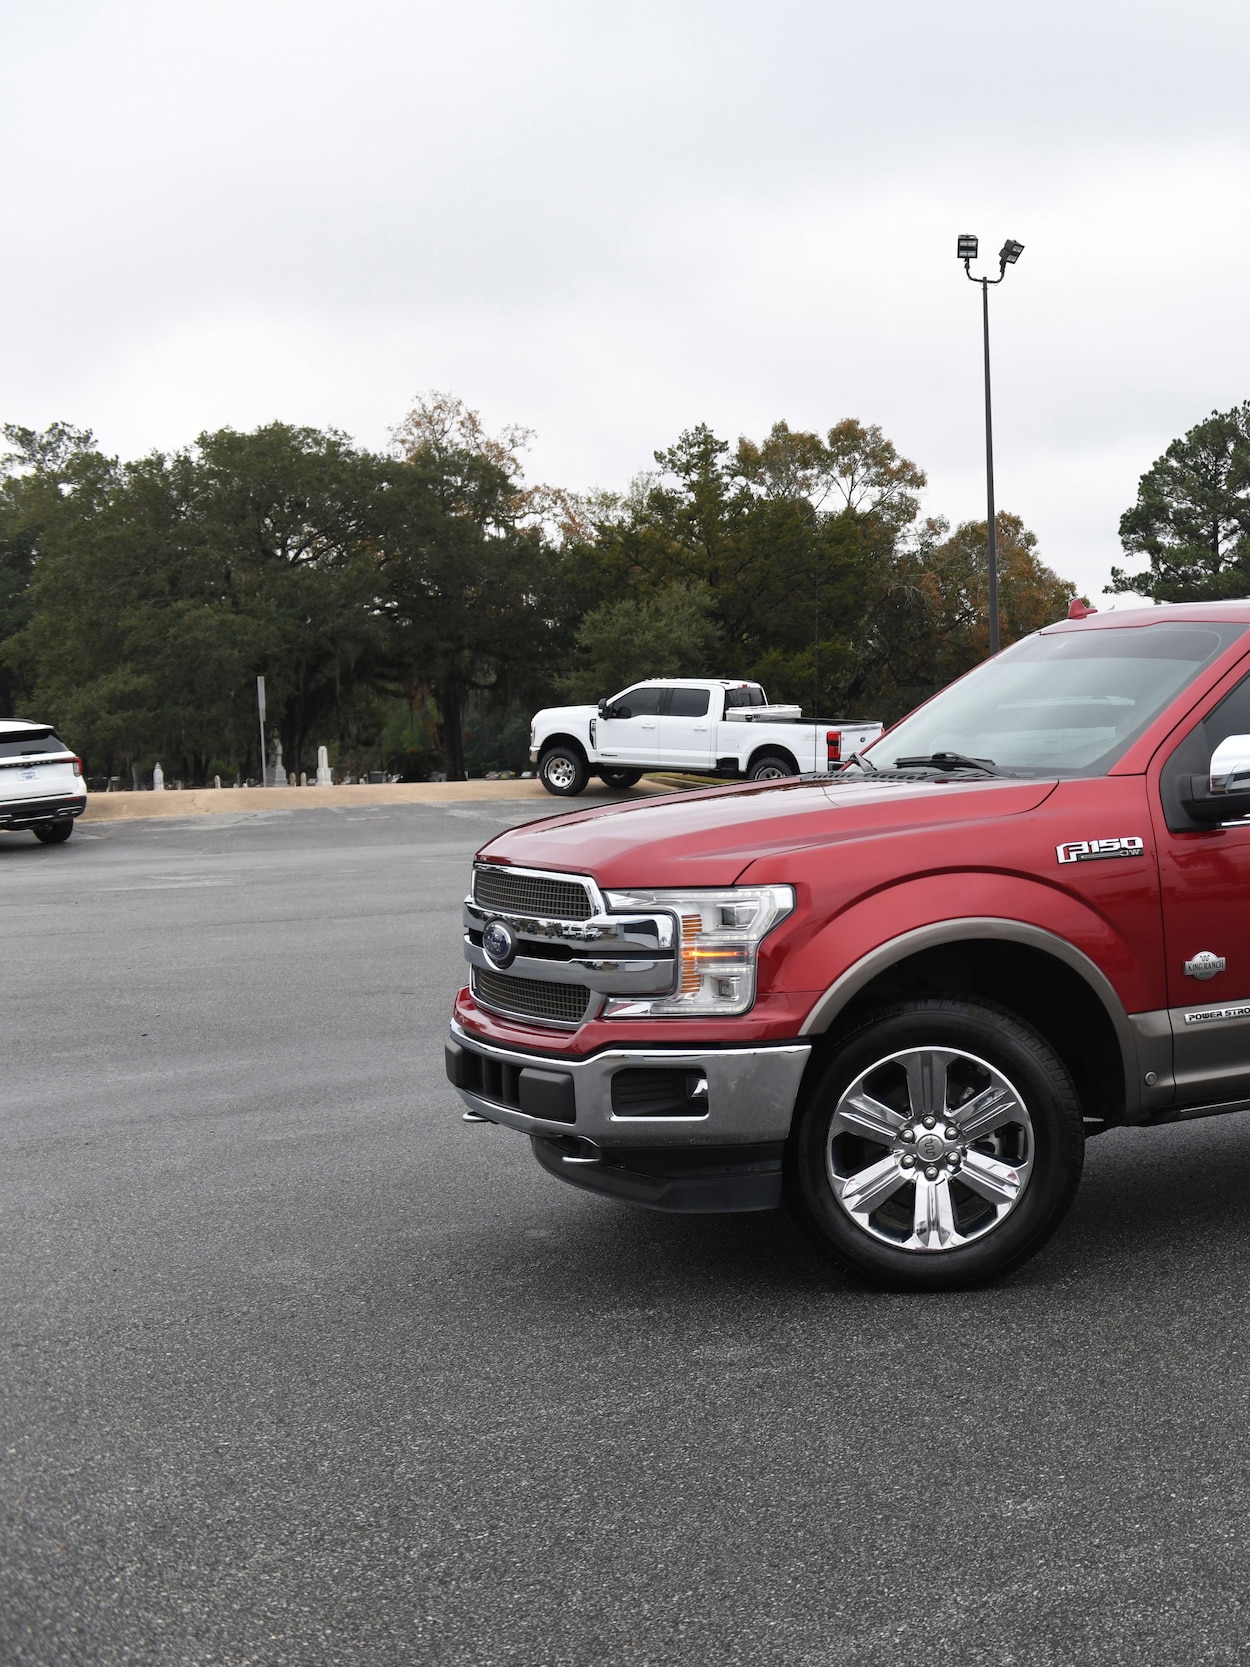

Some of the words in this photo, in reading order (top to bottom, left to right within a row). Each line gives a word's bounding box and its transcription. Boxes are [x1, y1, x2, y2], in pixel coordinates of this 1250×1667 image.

[1188, 963, 1203, 972] KING
[1203, 960, 1224, 970] RANCH
[1188, 1011, 1223, 1021] POWER
